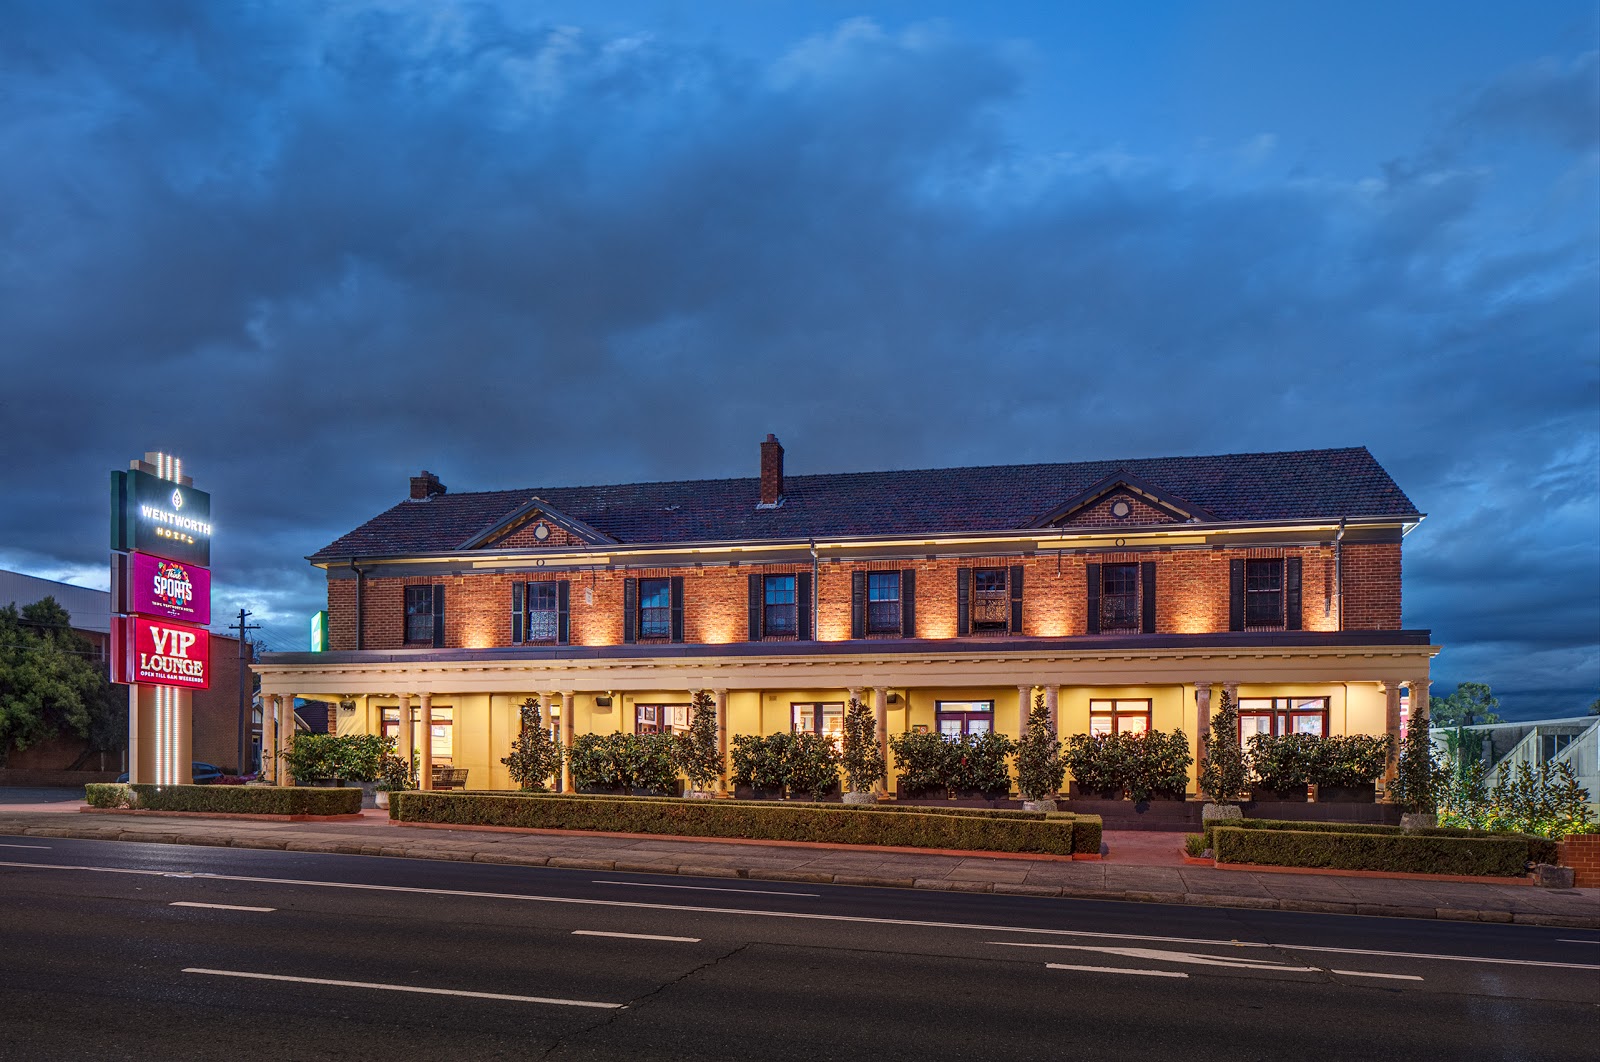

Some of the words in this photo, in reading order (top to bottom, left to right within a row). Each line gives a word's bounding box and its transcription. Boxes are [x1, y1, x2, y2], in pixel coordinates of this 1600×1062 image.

[141, 505, 211, 535] WENTWORTH
[157, 527, 194, 544] HOTEL
[153, 575, 193, 601] SPORTS
[149, 625, 196, 658] VIP
[140, 653, 204, 677] LOUNGE
[178, 675, 204, 683] WEEKENDS
